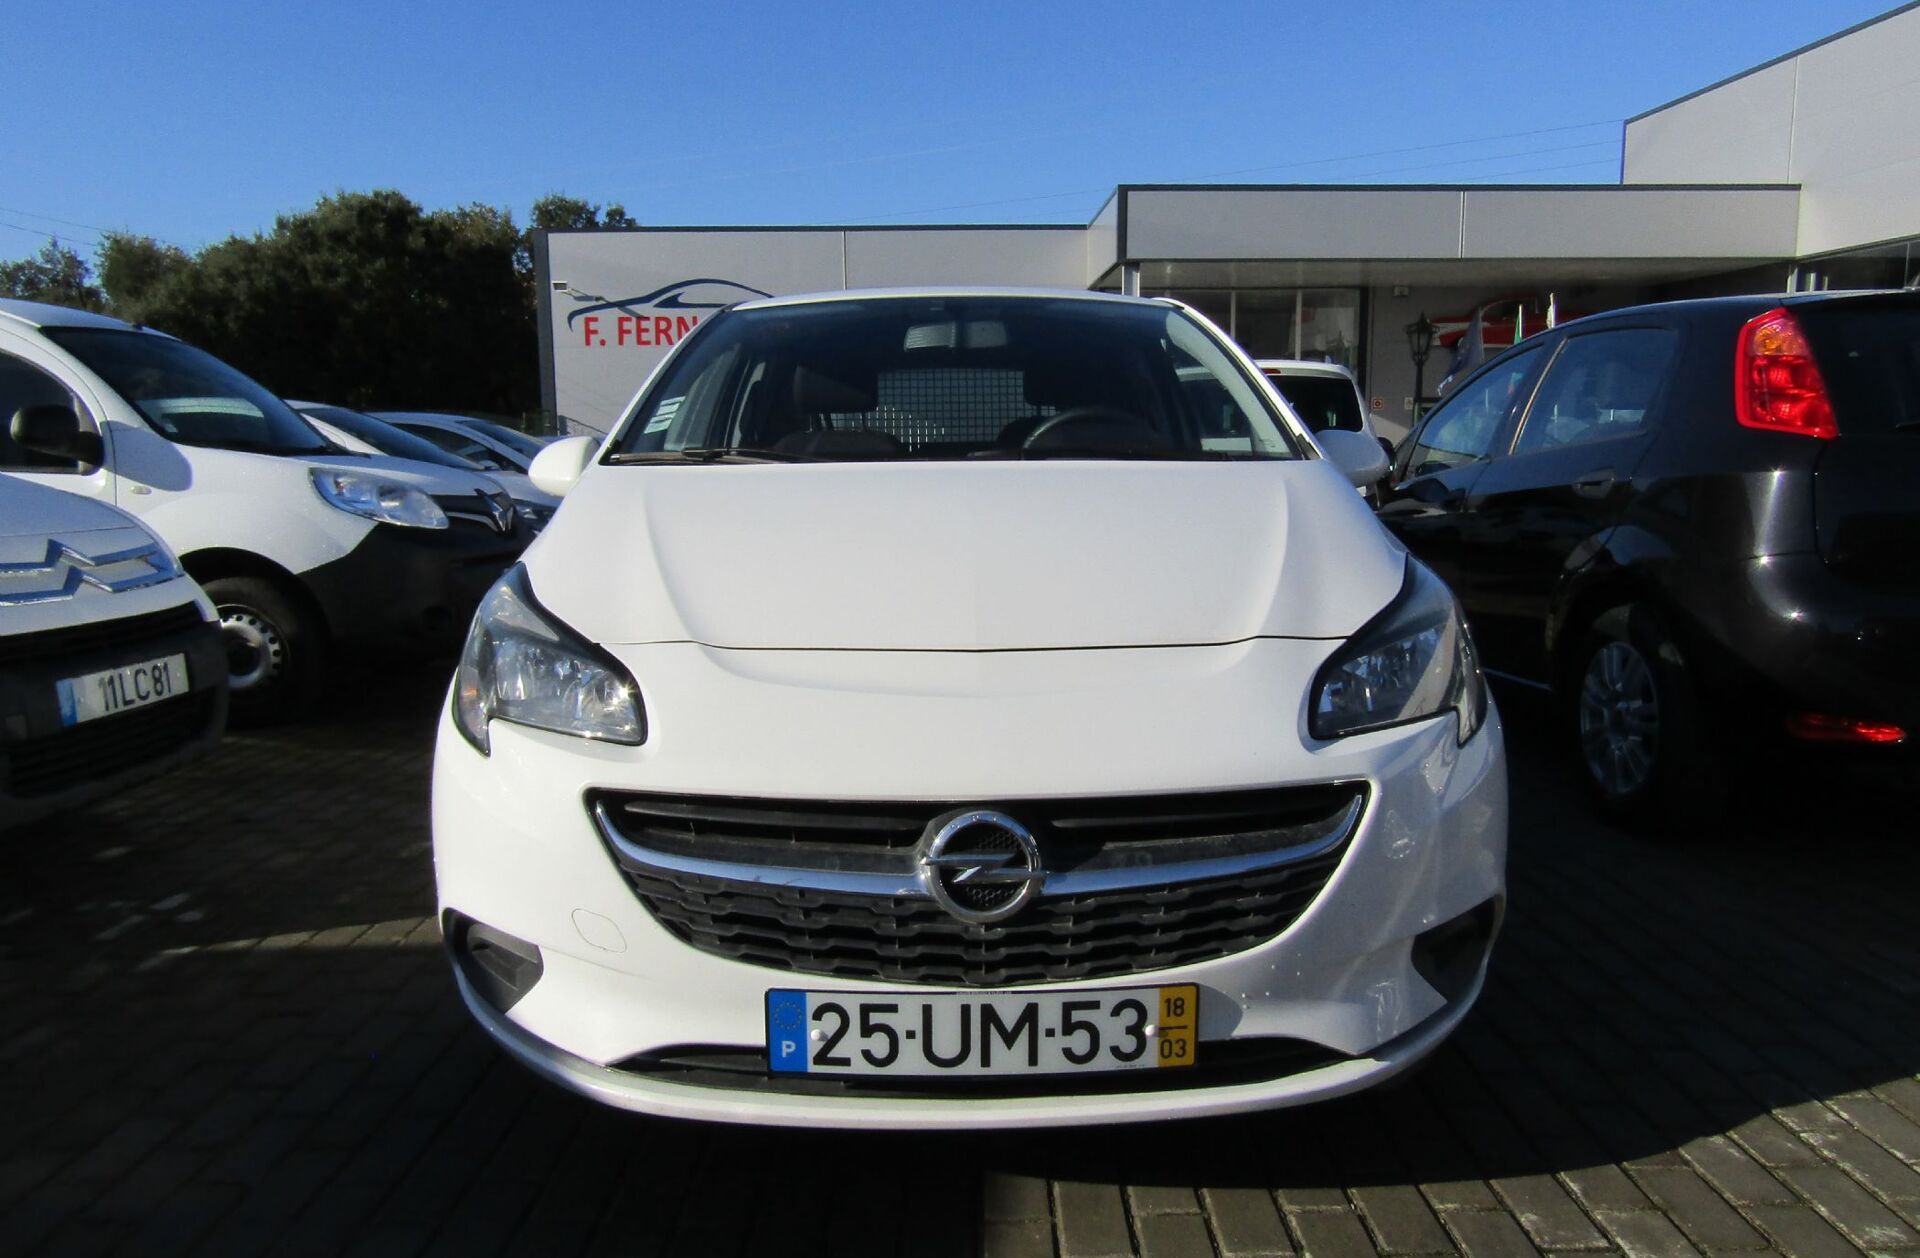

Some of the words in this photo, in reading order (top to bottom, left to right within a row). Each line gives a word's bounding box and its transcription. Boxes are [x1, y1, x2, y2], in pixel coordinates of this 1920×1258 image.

[584, 316, 607, 347] F.
[1164, 997, 1185, 1018] 18
[781, 1040, 796, 1058] P
[1160, 1038, 1187, 1059] 03
